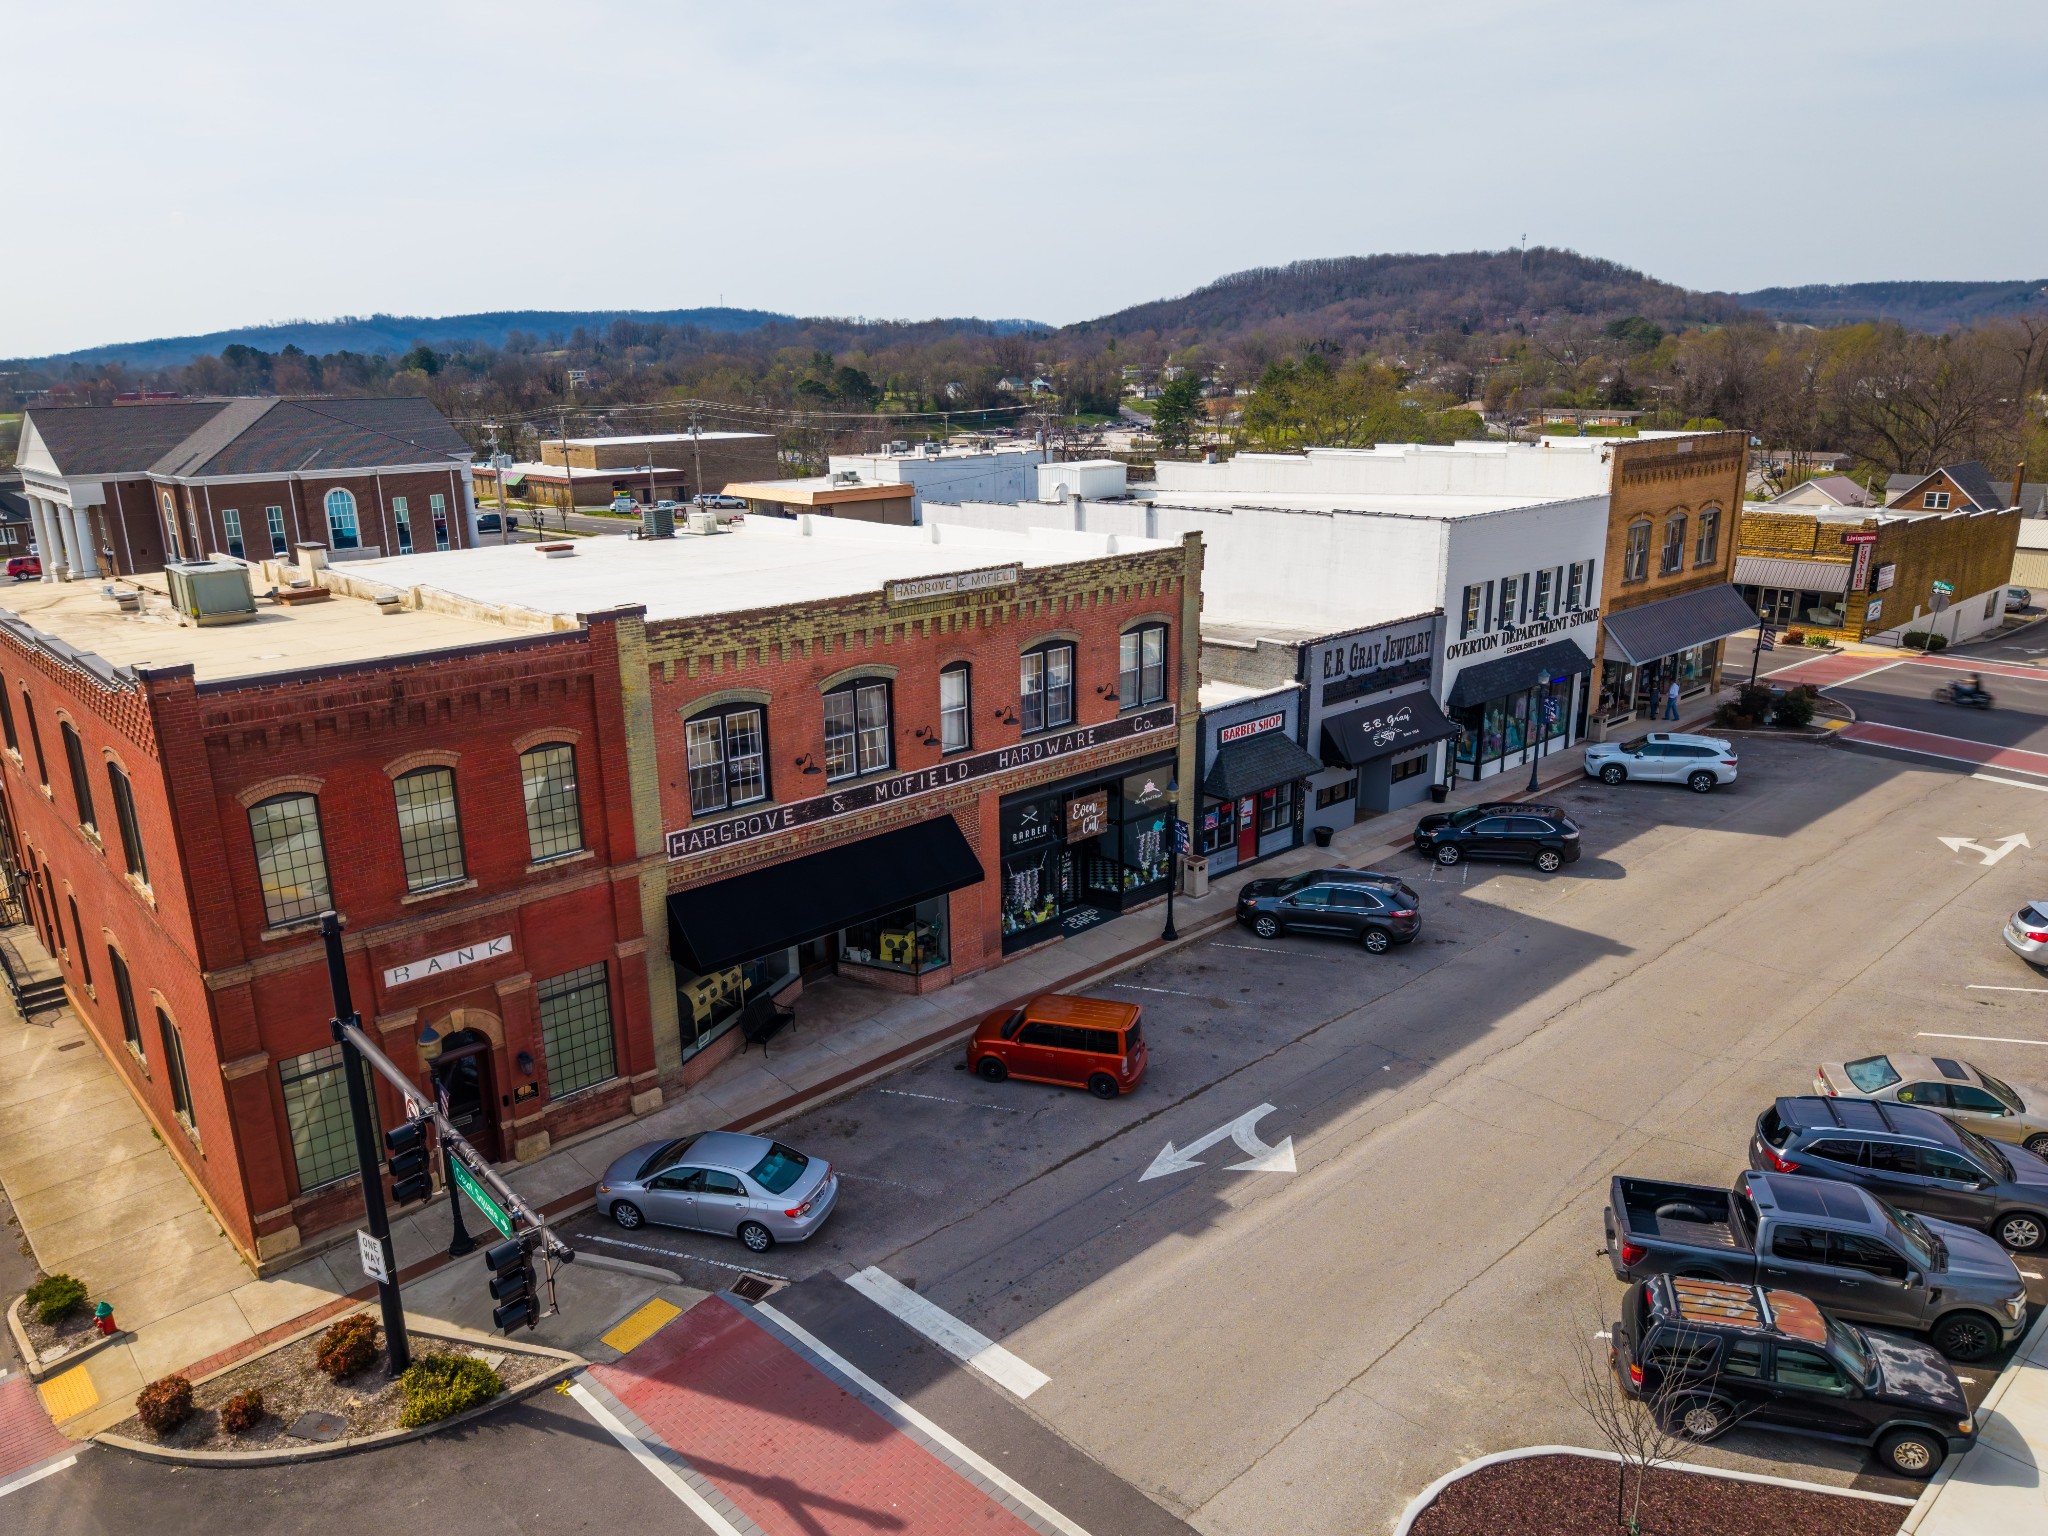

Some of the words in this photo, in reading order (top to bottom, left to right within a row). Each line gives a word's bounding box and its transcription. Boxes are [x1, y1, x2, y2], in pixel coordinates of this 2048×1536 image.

[1846, 534, 1876, 542] Livingston
[1855, 545, 1869, 588] FURNITURE
[895, 579, 951, 598] HARGROVE
[958, 576, 965, 588] &
[971, 569, 1015, 586] MOFIELD
[1446, 633, 1499, 660] OVERTON
[1501, 616, 1568, 646] DEPARTMENT
[1569, 607, 1600, 628] STORE
[1506, 640, 1537, 654] ESTABLISHED
[1223, 722, 1256, 742] BARBER
[1258, 715, 1281, 731] SHOP
[1387, 707, 1412, 727] Gray
[672, 807, 795, 855] HARGROVE
[832, 794, 845, 812] &
[875, 762, 968, 802] MOFIELD
[999, 729, 1096, 768] HARDWARE
[1012, 824, 1047, 842] BARBER
[393, 938, 503, 983] BANK
[362, 1237, 378, 1253] ONE
[363, 1249, 380, 1266] WAY
